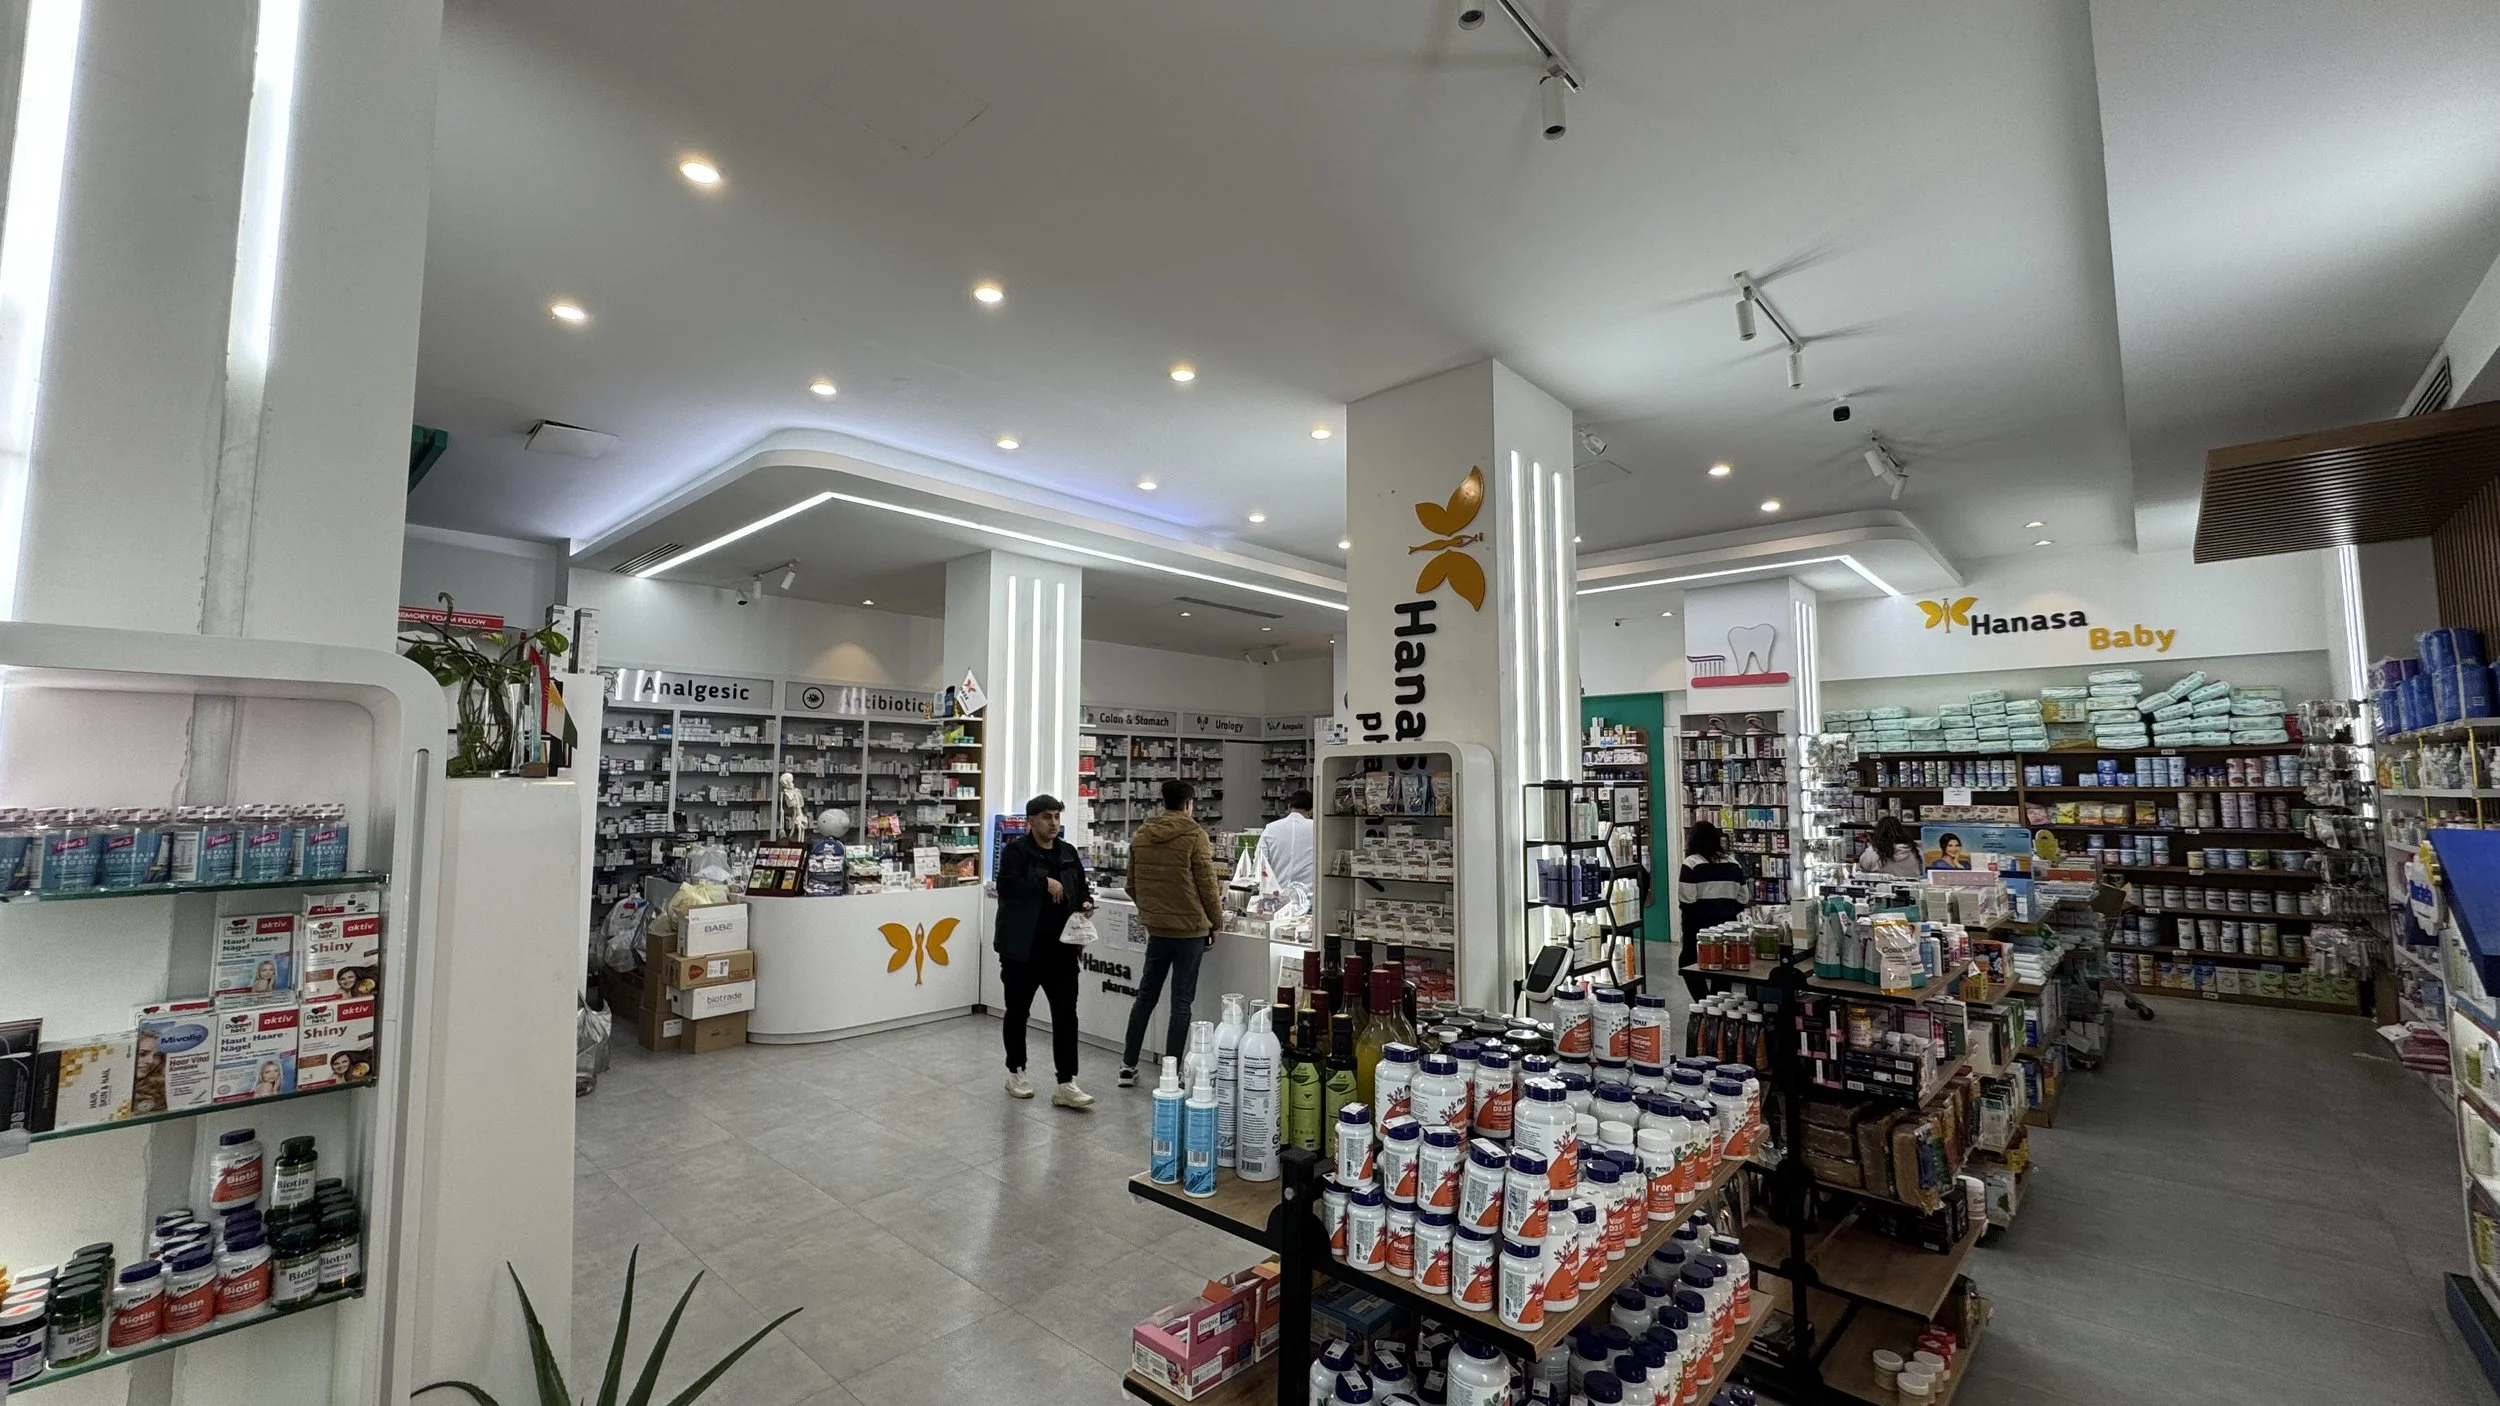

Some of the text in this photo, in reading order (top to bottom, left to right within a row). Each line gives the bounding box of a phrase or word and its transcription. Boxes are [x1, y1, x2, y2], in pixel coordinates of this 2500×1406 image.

[397, 611, 430, 620] EMORY
[458, 616, 486, 625] PILLOW
[1971, 610, 2089, 636] Hanasa
[2088, 624, 2176, 652] Baby
[642, 677, 750, 702] Analgesic
[1394, 599, 1437, 770] Hana
[1100, 713, 1169, 727] Colon & Stomach
[1215, 719, 1244, 732] Urology
[261, 920, 287, 929] aktiv
[347, 922, 374, 932] aktiv
[310, 941, 353, 954] Shiny
[1083, 952, 1132, 980] Hanasa
[706, 992, 742, 1004] biotrade
[342, 1005, 369, 1015] aktiv
[263, 1015, 293, 1025] aktiv
[221, 1032, 283, 1046] Haut Haare
[304, 1025, 348, 1040] Shiny
[226, 1169, 259, 1184] Biotin
[278, 1177, 309, 1190] Biotin
[1652, 1182, 1673, 1192] Iron
[223, 1279, 260, 1296] Biotin
[170, 1298, 204, 1313] Biotin
[119, 1310, 155, 1327] Biotin
